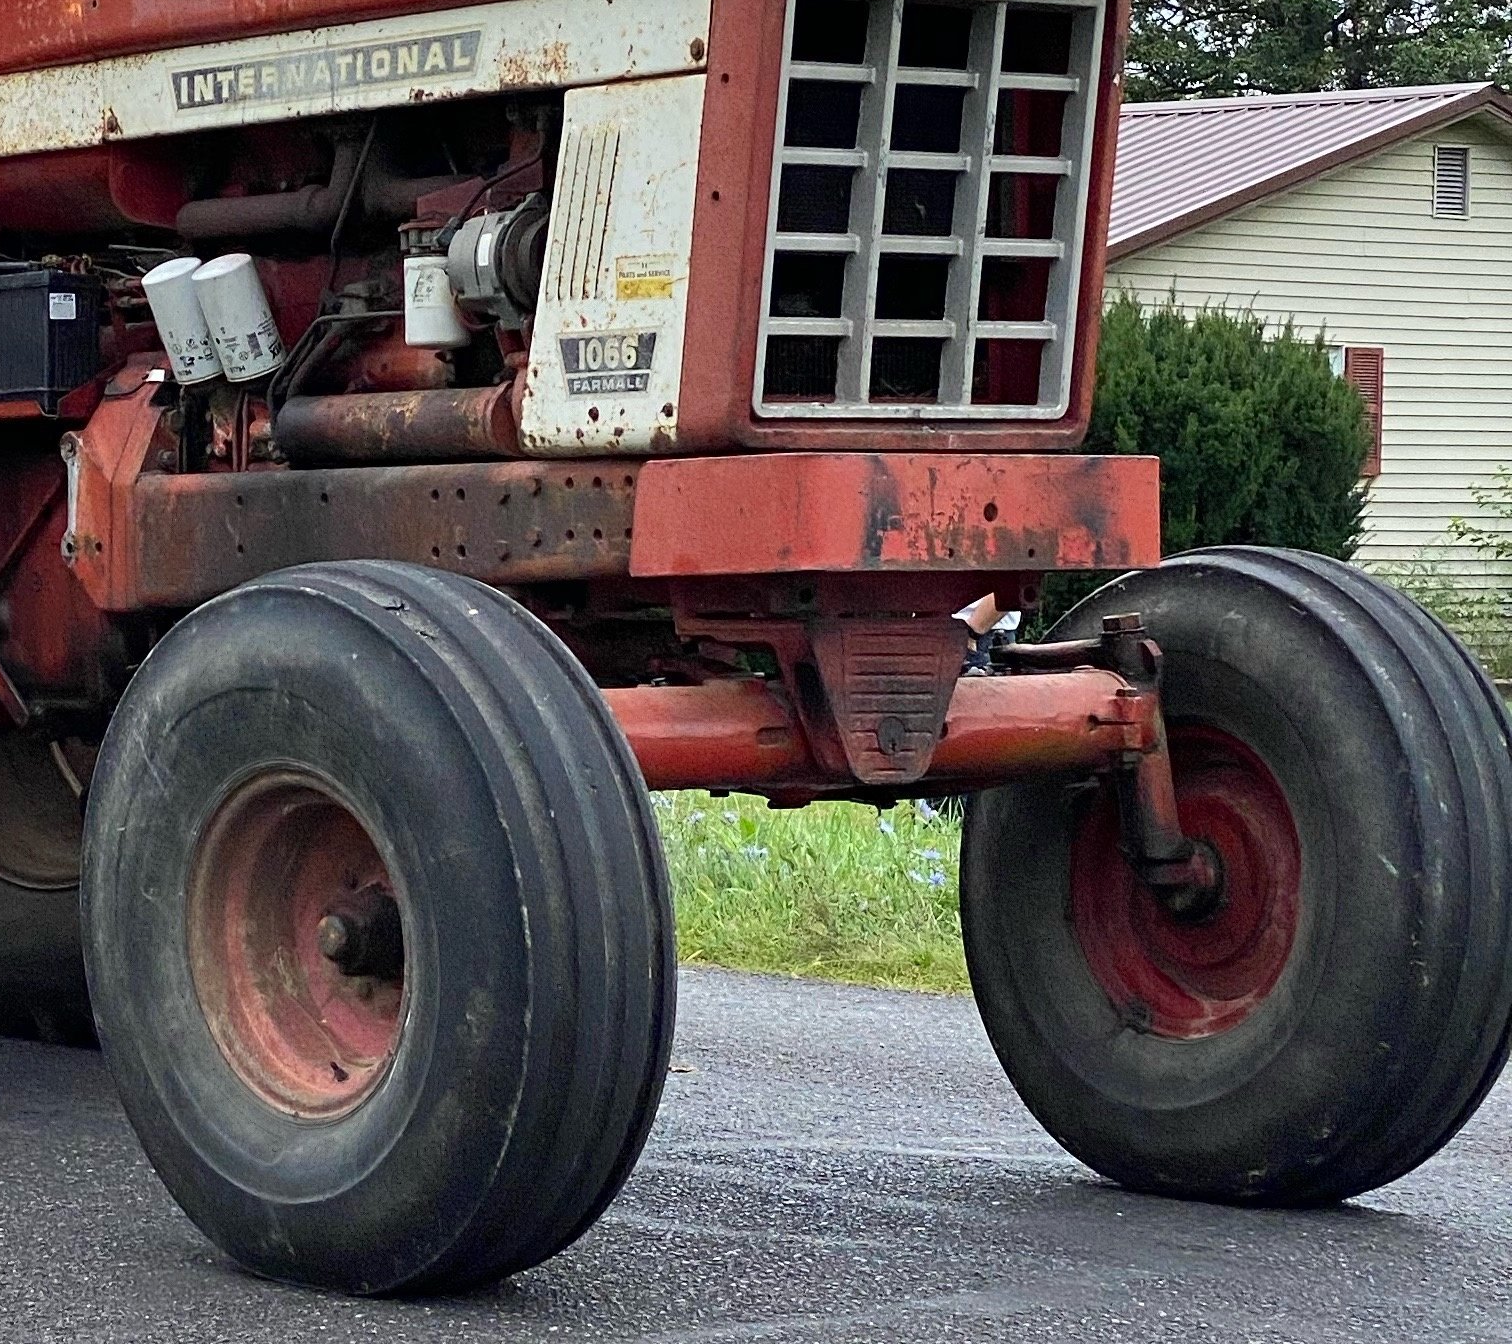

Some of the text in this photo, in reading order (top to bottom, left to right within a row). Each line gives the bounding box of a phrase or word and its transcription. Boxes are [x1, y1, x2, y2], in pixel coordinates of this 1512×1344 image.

[178, 38, 472, 104] INTERNATIONAL
[577, 336, 639, 371] 1066
[571, 374, 644, 393] FARMALL
